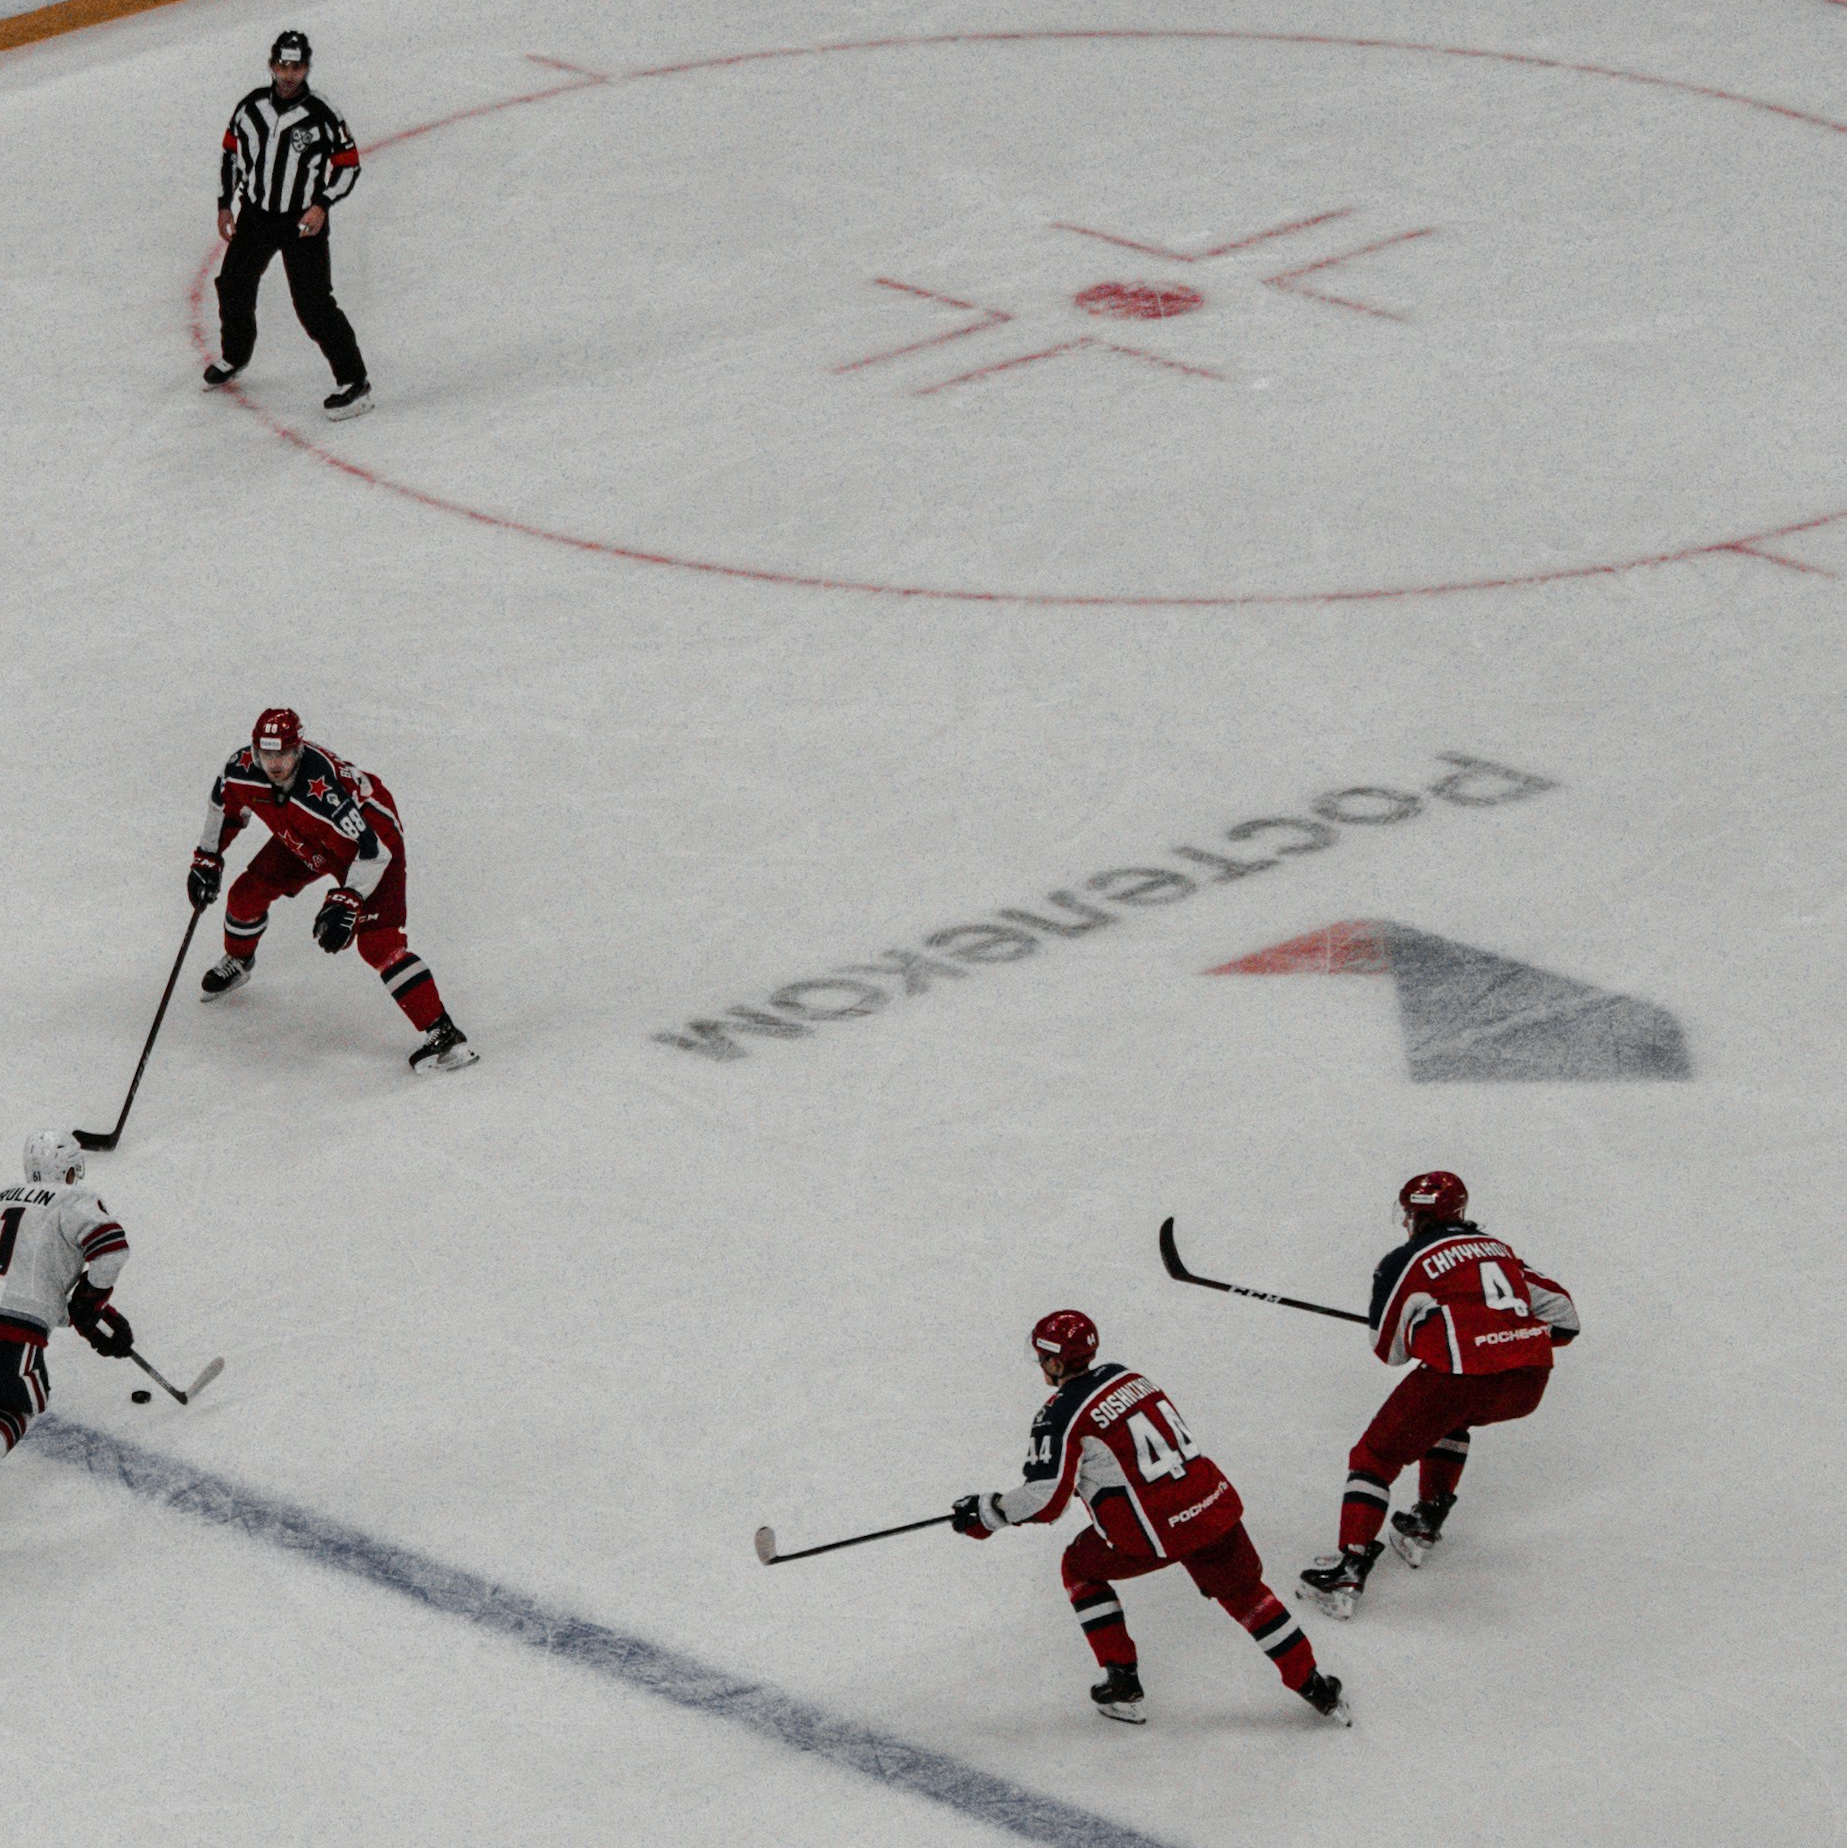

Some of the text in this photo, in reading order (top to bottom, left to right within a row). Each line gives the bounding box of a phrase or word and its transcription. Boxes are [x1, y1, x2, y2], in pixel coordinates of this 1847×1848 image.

[338, 808, 367, 840] 88
[1478, 1259, 1531, 1319] 4
[1125, 1399, 1202, 1485] 44
